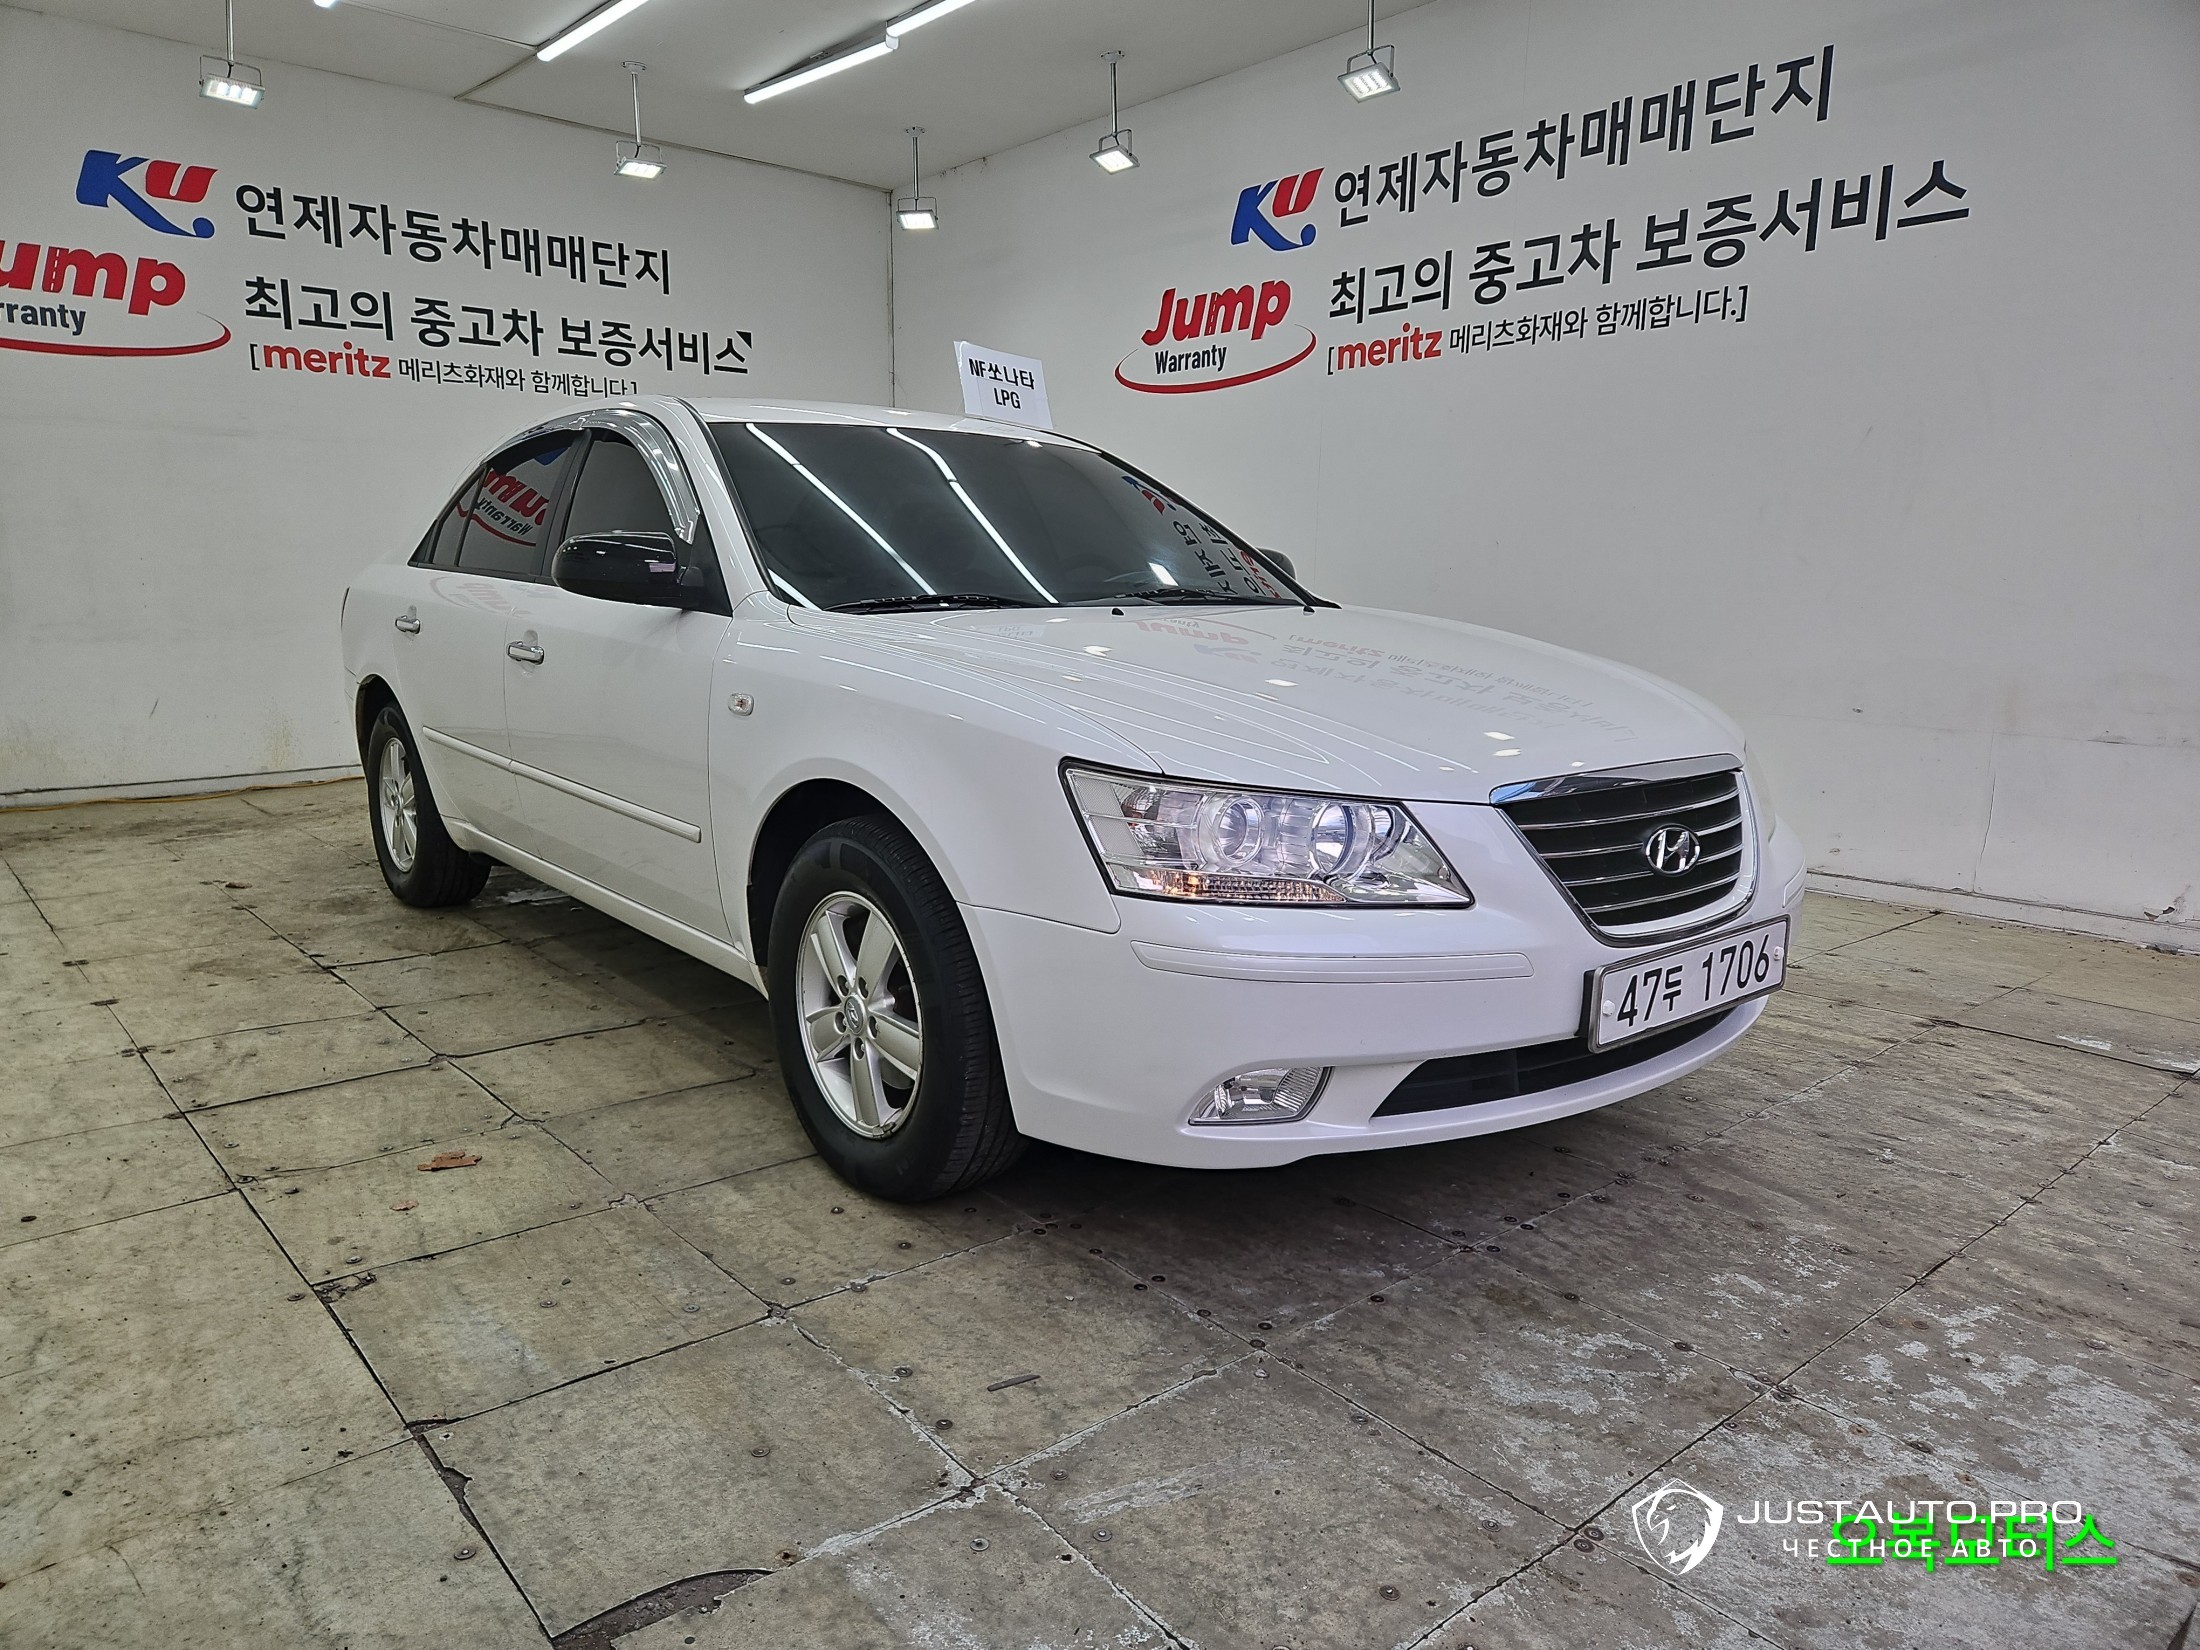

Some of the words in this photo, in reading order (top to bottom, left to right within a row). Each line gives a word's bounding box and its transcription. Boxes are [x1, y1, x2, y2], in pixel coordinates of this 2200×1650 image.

[1334, 44, 1834, 228] 연제자동차매매단지
[236, 184, 670, 295] 연제자동차매매단지
[1329, 249, 1453, 324] 최고의
[1469, 218, 1621, 305] 중고차
[1636, 159, 1970, 269] 보증서비스
[245, 276, 394, 341] 최고의
[410, 297, 544, 357] 중고차
[557, 317, 749, 374] 보증서비스
[1141, 280, 1291, 346] Jump
[1450, 306, 1588, 353] 메리츠화재와
[398, 358, 525, 392] 메리츠화재와
[968, 358, 1035, 390] NF쏘나타
[1155, 344, 1227, 375] Warranty
[993, 387, 1021, 409] LPG
[1617, 965, 1683, 1027] 47두
[1702, 934, 1770, 1001] 1706
